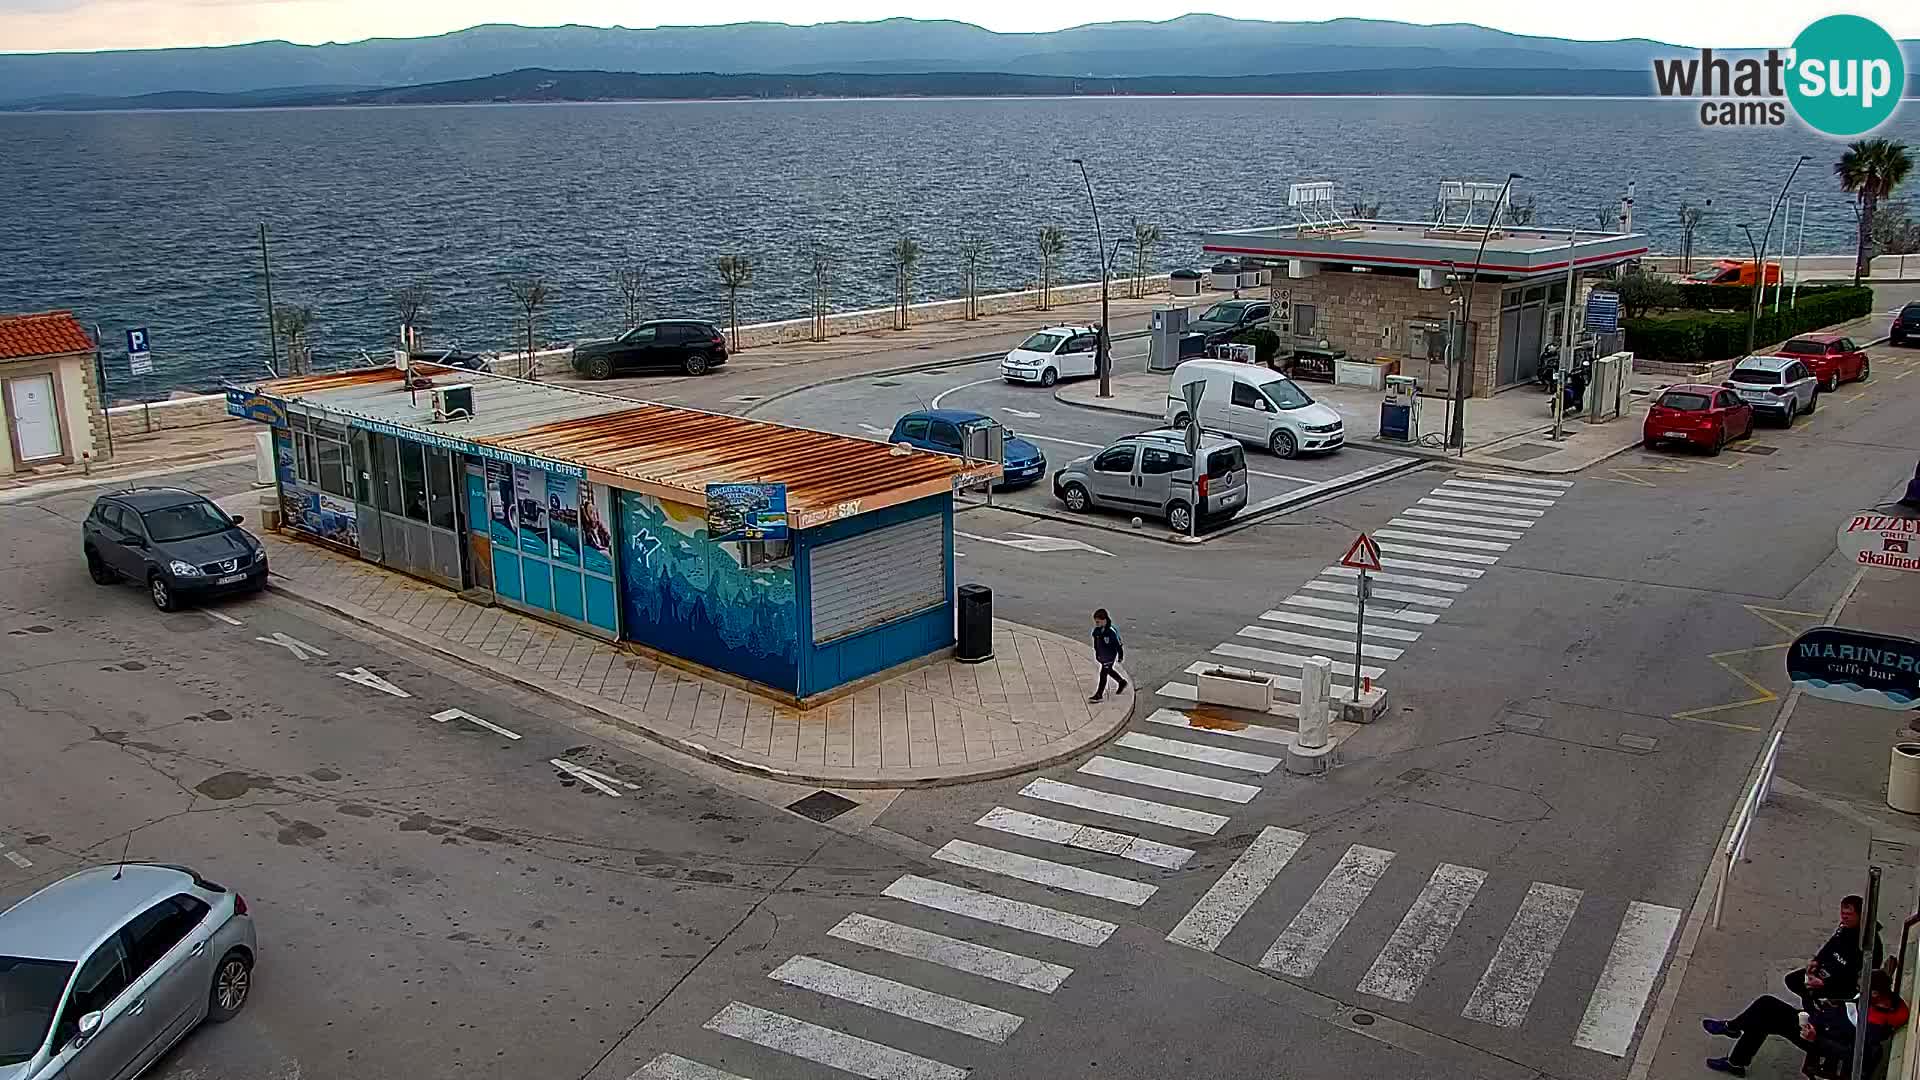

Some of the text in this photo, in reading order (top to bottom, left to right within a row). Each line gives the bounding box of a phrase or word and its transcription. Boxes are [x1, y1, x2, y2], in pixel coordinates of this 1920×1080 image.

[131, 331, 143, 350] P
[397, 428, 437, 445] AUTOBUSNA
[437, 436, 468, 452] POSTAJA
[479, 446, 493, 457] BUS
[494, 448, 527, 465] STATION
[529, 457, 555, 470] TICKET
[555, 463, 583, 478] OFFICE
[1846, 516, 1920, 534] PIZZE
[1880, 531, 1916, 541] GRILL
[1827, 663, 1896, 680] caffe bar
